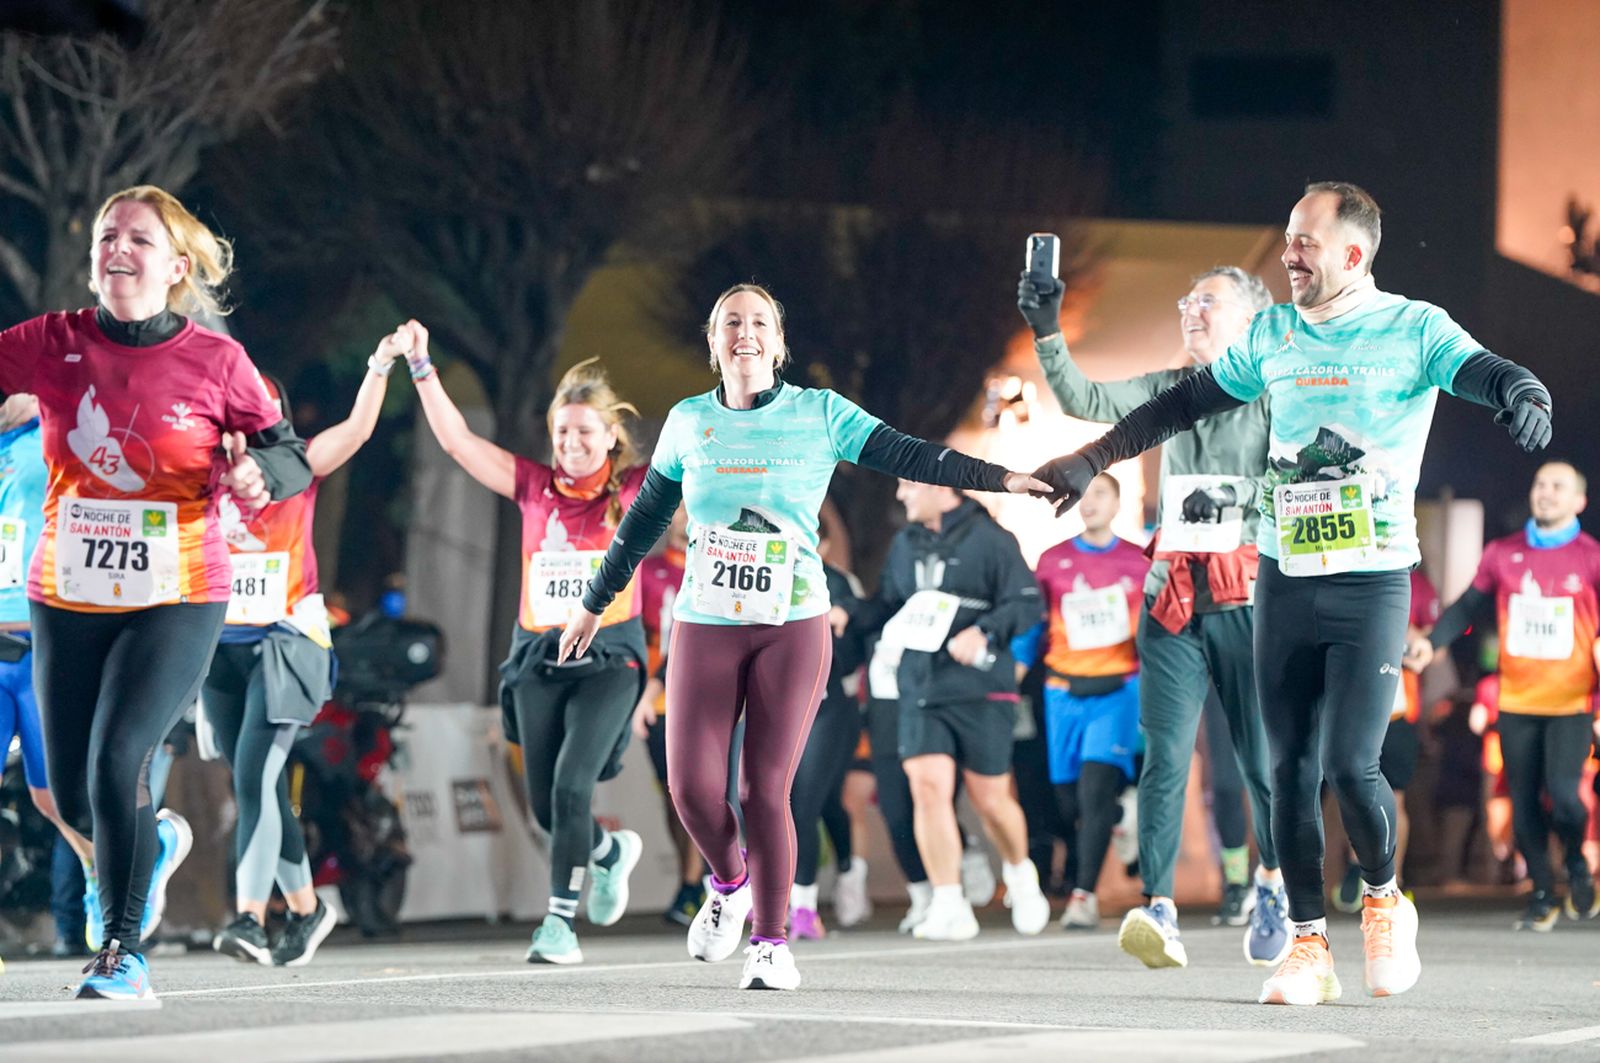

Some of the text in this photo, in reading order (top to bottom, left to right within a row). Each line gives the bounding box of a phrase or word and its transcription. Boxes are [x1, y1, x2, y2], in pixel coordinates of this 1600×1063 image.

[1297, 365, 1349, 376] CAZORLA
[1352, 366, 1397, 377] TRAILS
[1295, 377, 1349, 387] QUESADA
[88, 446, 120, 476] 43
[718, 458, 768, 466] CAZORLA
[769, 458, 806, 466] TRAILS
[715, 466, 768, 474] QUESADA
[1294, 491, 1332, 503] NOCHE DE
[1285, 504, 1302, 516] SAN
[1302, 501, 1333, 515] ANTÓN
[83, 511, 131, 525] NOCHE DE
[69, 522, 91, 535] SAN
[93, 524, 131, 538] ANTÓN
[1292, 513, 1356, 545] 2855
[718, 537, 745, 552] NOCHE
[745, 542, 758, 552] DE
[82, 538, 149, 571] 7273
[707, 546, 723, 560] SAN
[724, 550, 757, 564] ANTÓN
[711, 560, 772, 593] 2166
